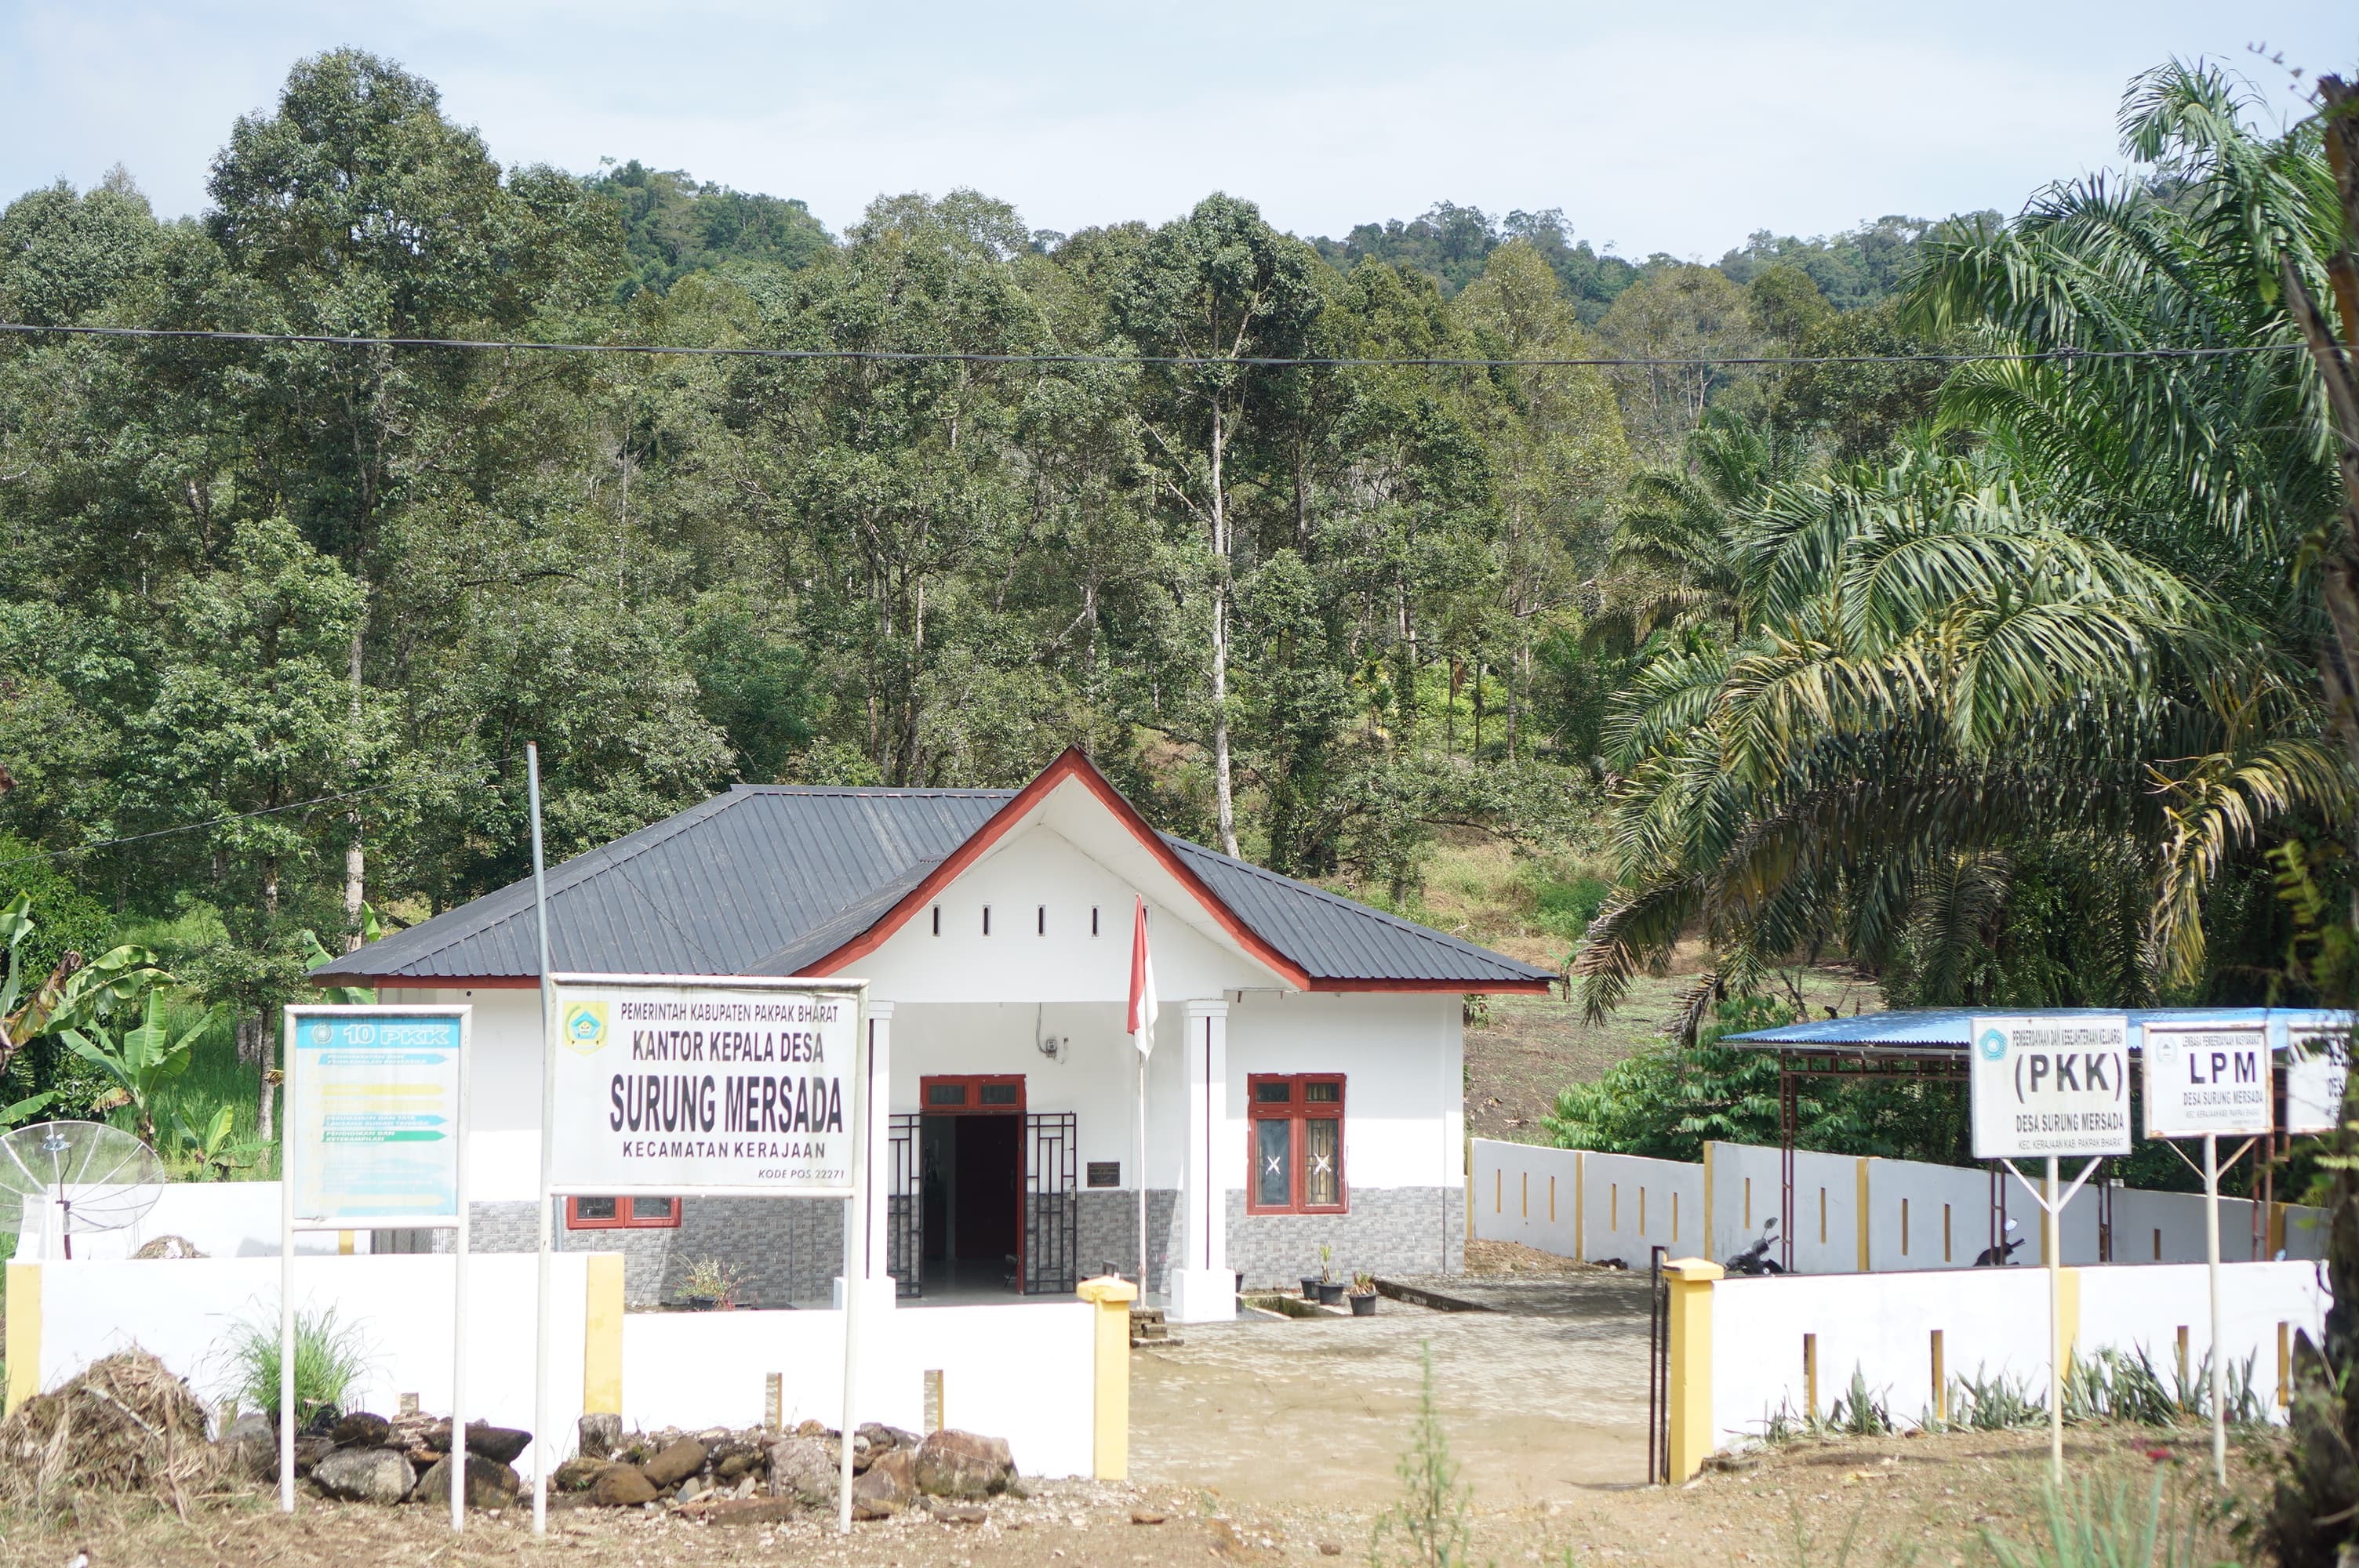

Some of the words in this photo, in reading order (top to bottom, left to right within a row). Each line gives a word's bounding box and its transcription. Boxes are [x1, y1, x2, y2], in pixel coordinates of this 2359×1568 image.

[621, 1003, 687, 1021] PEMERINTAH
[691, 1004, 751, 1022] KABUPATEN
[754, 1004, 794, 1022] PAKPAK
[798, 1005, 838, 1023] BHARAT
[343, 1024, 376, 1044] 10
[380, 1029, 450, 1045] PKK
[2012, 1029, 2049, 1047] PEMBERDAYAAN
[2050, 1029, 2060, 1046] DAN
[2061, 1029, 2098, 1046] KESEJAHTERAAN
[2099, 1028, 2122, 1044] KELUARGA
[633, 1030, 703, 1062] KANTOR
[710, 1032, 774, 1062] KEPALA
[780, 1033, 824, 1063] DESA
[2190, 1051, 2256, 1084] LPM
[2015, 1052, 2123, 1104] (PKK)
[610, 1074, 716, 1133] SURUNG
[725, 1076, 843, 1134] MERSADA
[2183, 1092, 2201, 1105] DESA
[2203, 1091, 2230, 1105] SURUNG
[2233, 1091, 2263, 1105] MERSADA
[2016, 1114, 2039, 1133] DESA
[2042, 1113, 2078, 1132] SURUNG
[2081, 1112, 2125, 1131] MERSADA
[623, 1141, 729, 1158] KECAMATAN
[735, 1142, 825, 1159] KERAJAAN
[2033, 1139, 2063, 1149] KERAJAAN
[2078, 1138, 2101, 1149] PAKPAK
[2102, 1138, 2123, 1148] BHARAT
[758, 1169, 787, 1179] KODE
[791, 1169, 812, 1179] POS
[815, 1169, 845, 1180] 22271
